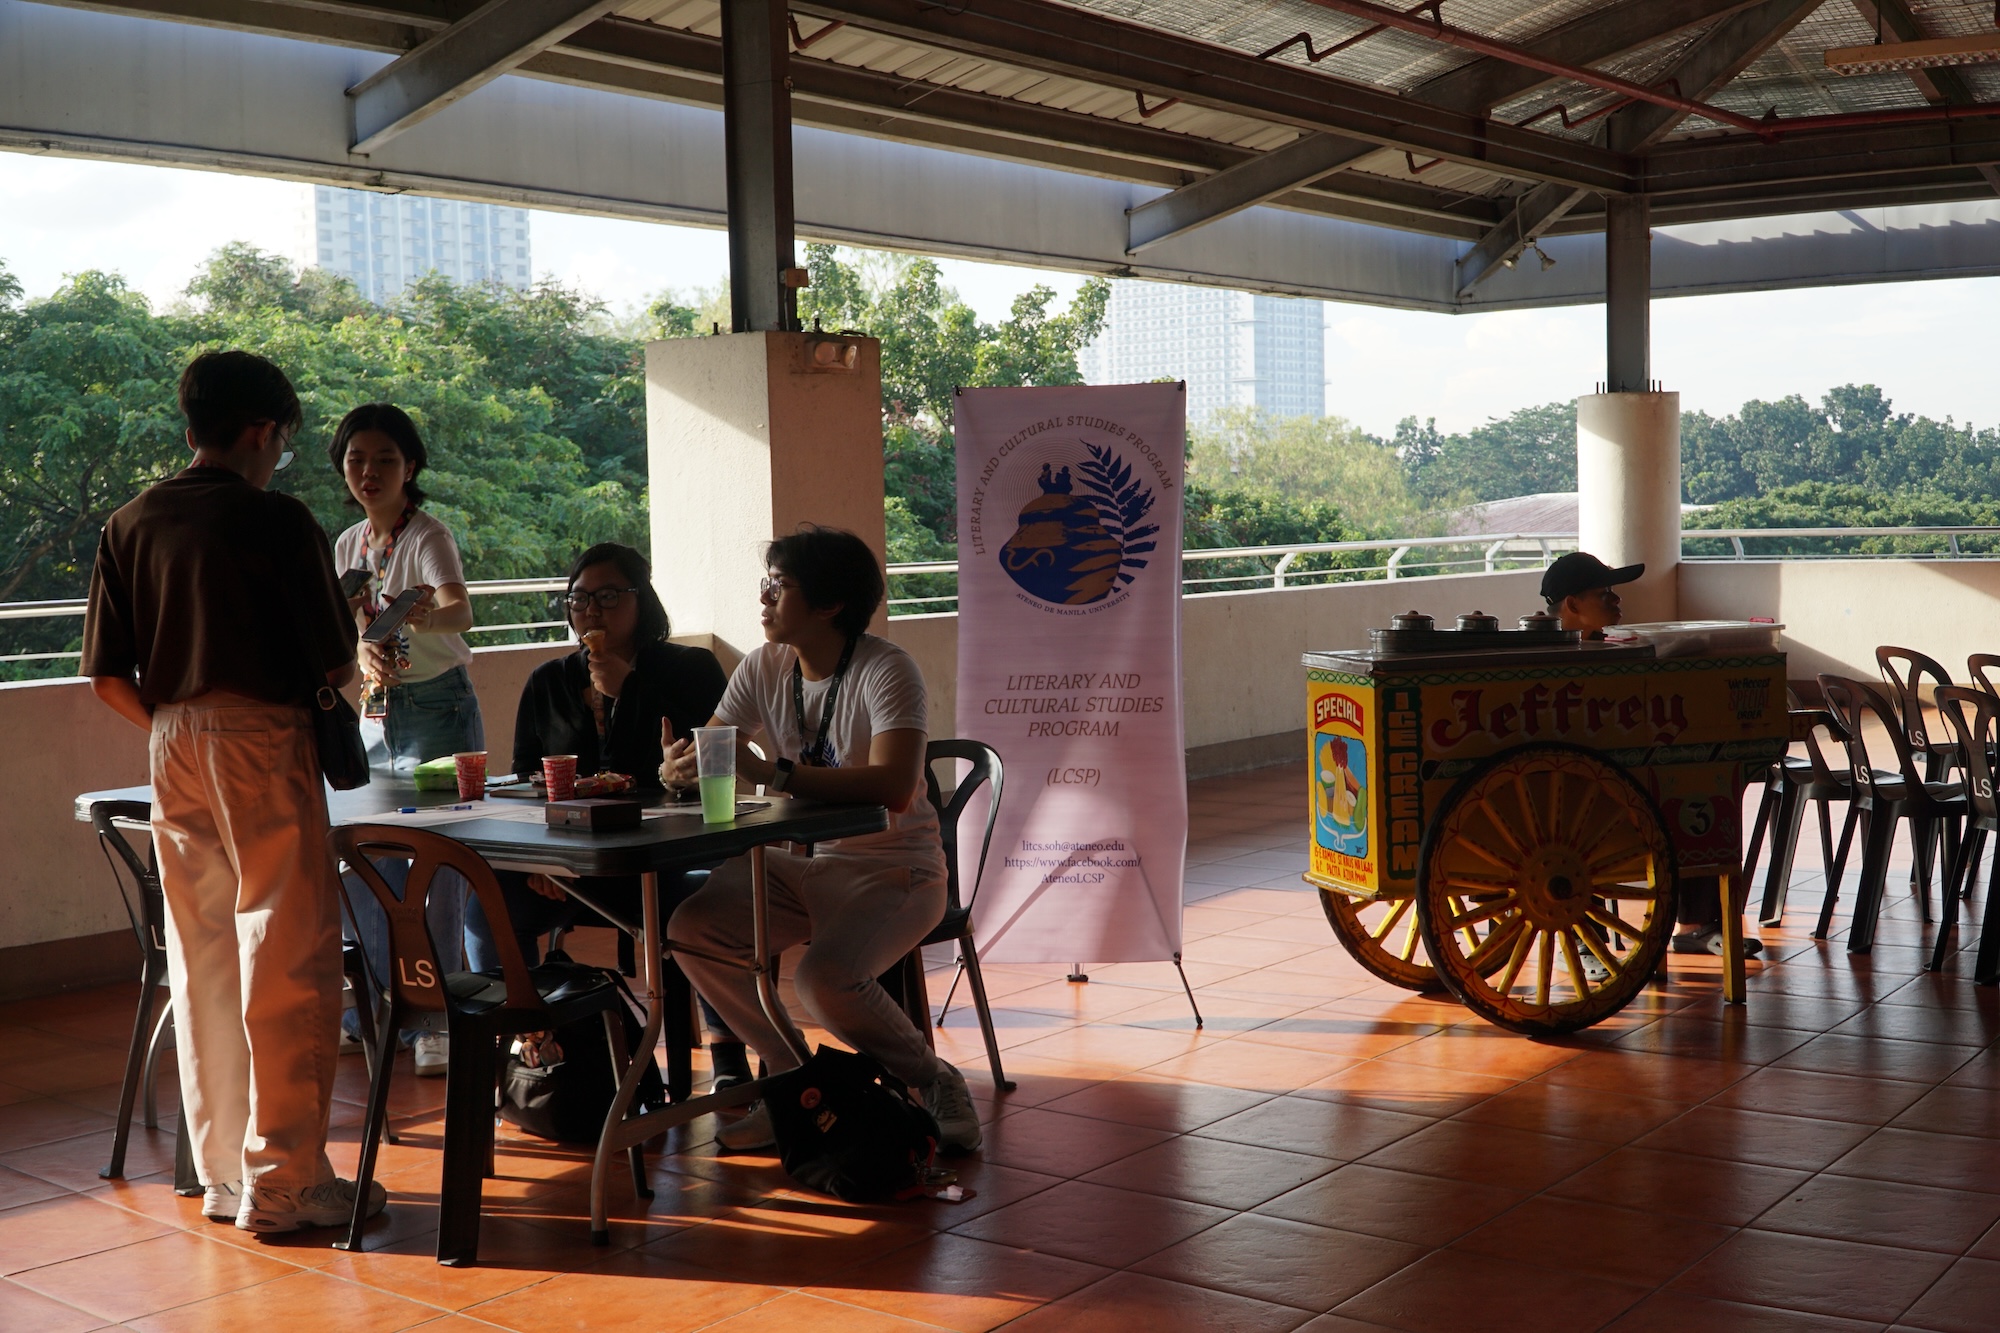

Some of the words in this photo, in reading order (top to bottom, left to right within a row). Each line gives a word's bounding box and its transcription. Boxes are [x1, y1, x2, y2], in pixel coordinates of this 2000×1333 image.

[970, 488, 985, 556] LITERARY
[983, 459, 1000, 485] AND
[999, 417, 1063, 457] CULTURAL
[1067, 415, 1126, 437] STUDIES
[1127, 432, 1175, 490] PROGRAM
[1016, 592, 1043, 612] ATENEO
[1044, 605, 1055, 614] DE
[1056, 606, 1087, 616] MANILA
[1088, 591, 1131, 615] UNIVERSITY
[1006, 673, 1097, 691] LITERARY
[1098, 672, 1141, 690] AND
[984, 697, 1081, 715] CULTURAL
[1085, 696, 1164, 713] STUDIES
[1728, 689, 1771, 711] SPECIAL
[1316, 696, 1362, 728] SPECIAL
[1387, 691, 1418, 747] ICE
[1430, 680, 1689, 749] Jeffrey
[1026, 720, 1121, 738] PROGRAM
[1908, 729, 1925, 747] LS
[1046, 767, 1101, 787] (LCSP)
[1853, 763, 1870, 785] LS
[1972, 776, 1993, 799] LS
[1389, 752, 1420, 872] CREAM
[1687, 801, 1711, 836] 3
[1022, 839, 1125, 852] litcs.soh@ateneo.edu
[1004, 856, 1142, 870] https://www.facebook.com/
[1041, 873, 1105, 884] AteneoLCSP
[150, 924, 166, 951] L
[398, 957, 436, 989] LS
